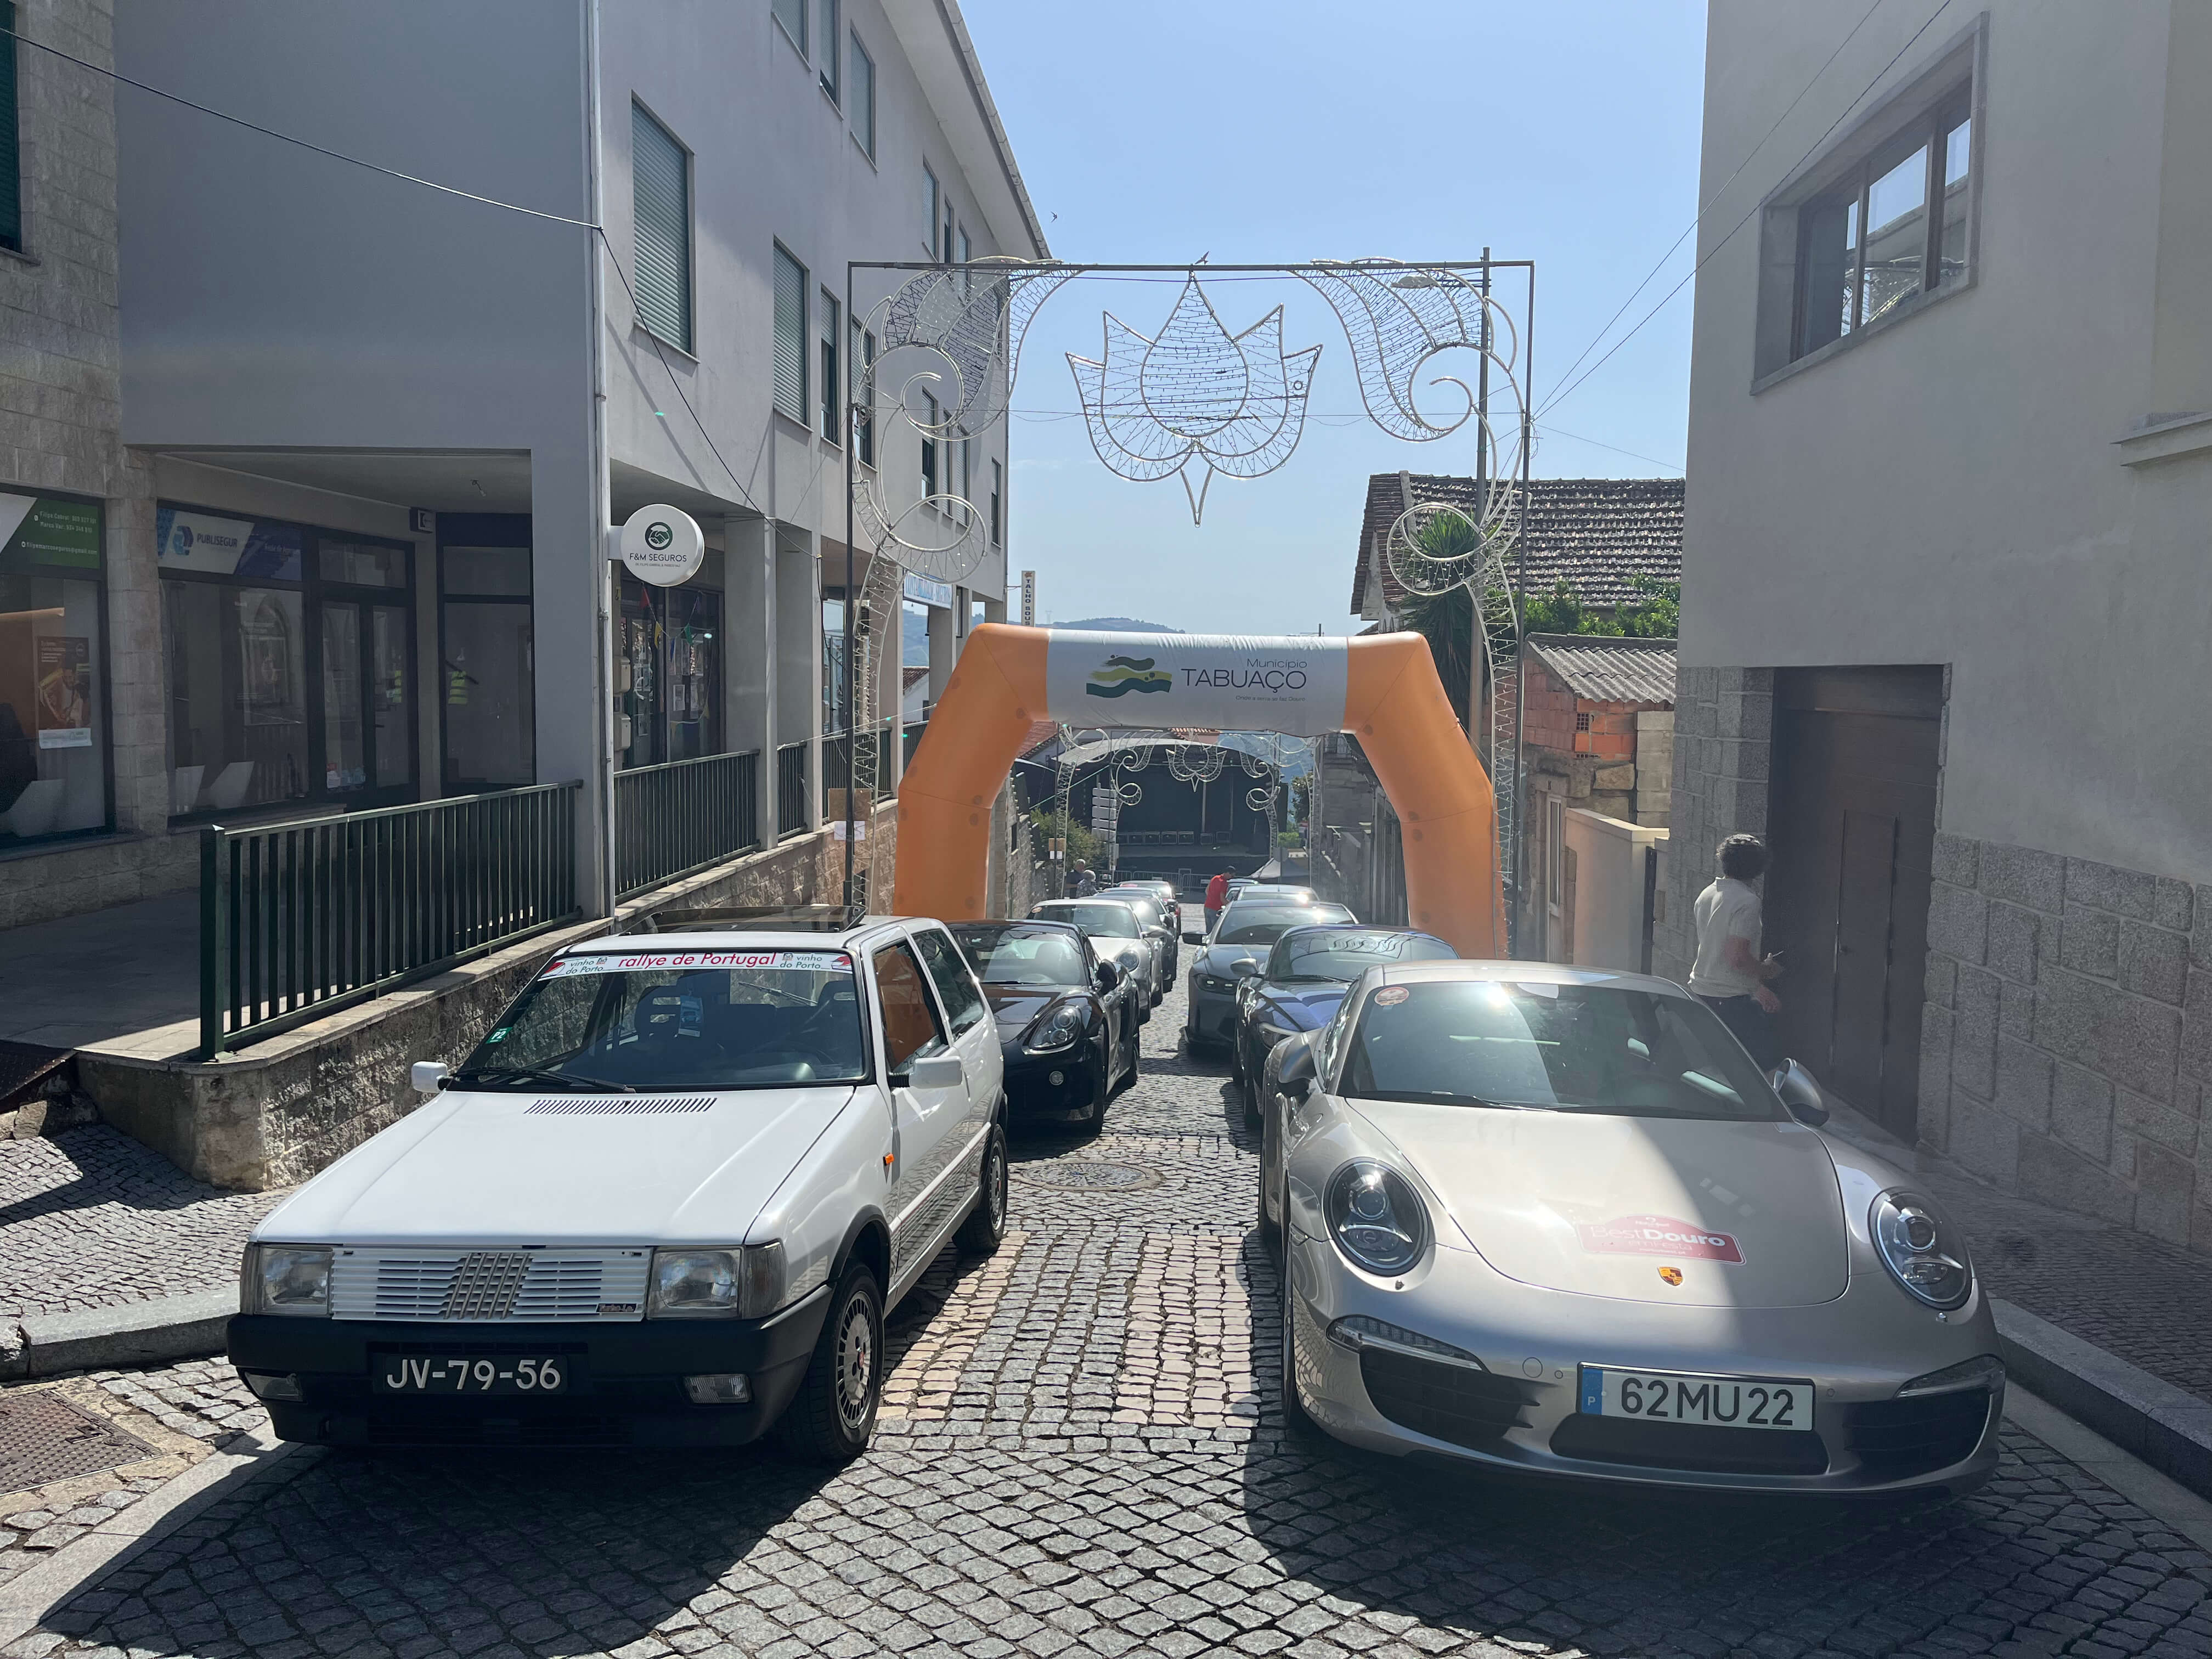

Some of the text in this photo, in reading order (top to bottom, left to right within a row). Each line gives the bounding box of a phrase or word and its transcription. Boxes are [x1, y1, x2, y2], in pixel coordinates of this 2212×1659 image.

[197, 533, 238, 548] PUBLISEGUR
[629, 552, 687, 562] F&M SEGUROS
[1246, 658, 1307, 670] Município
[1181, 668, 1307, 693] TABUAÇO
[570, 957, 594, 967] vinho
[618, 952, 777, 969] rallye de Portugal
[565, 965, 603, 975] do Porto
[492, 1031, 506, 1040] P2
[387, 1359, 561, 1390] JV-79-56
[1587, 1396, 1596, 1406] P
